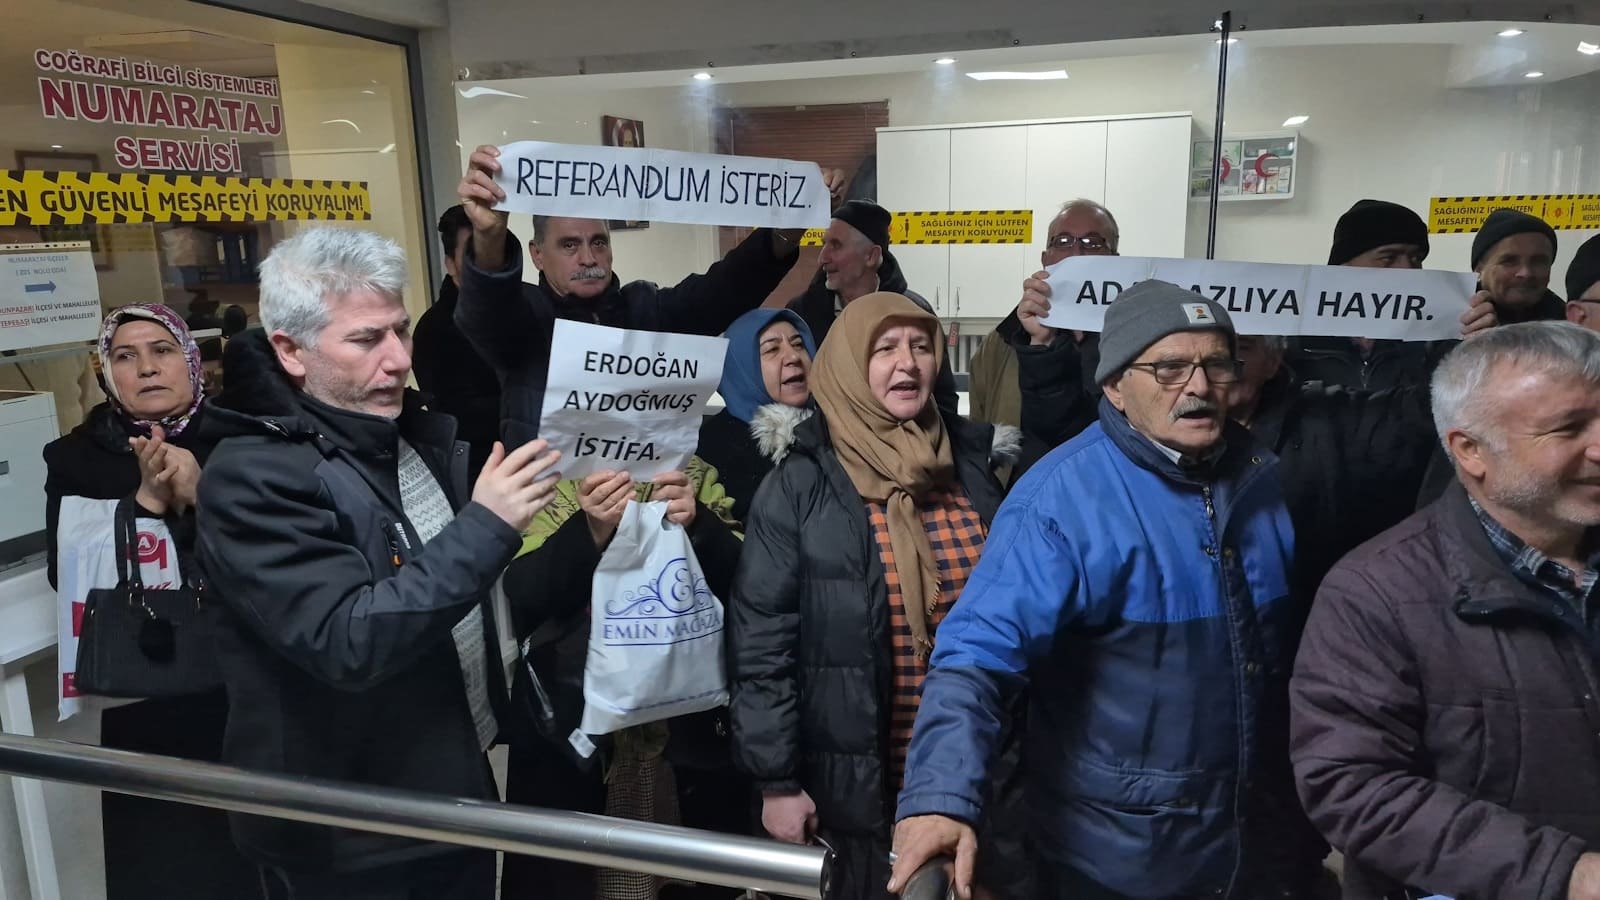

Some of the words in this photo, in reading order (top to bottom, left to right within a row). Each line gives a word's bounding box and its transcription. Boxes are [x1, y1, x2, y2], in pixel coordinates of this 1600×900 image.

[34, 48, 129, 80] COĞRAFİ
[133, 59, 183, 86] BİLGİ
[186, 66, 279, 98] SİSTEMLERİ
[38, 76, 282, 137] NUMARATAJ
[115, 135, 242, 173] SERVİSİ
[516, 156, 710, 203] REFERANDUM
[720, 164, 812, 209] İSTERİZ.
[40, 185, 149, 212] GÜVENLİ
[158, 188, 259, 212] MESAFEYİ
[266, 192, 363, 212] KORUYALIM!
[921, 219, 971, 227] SAĞLIĞINIZ
[975, 219, 993, 227] İÇİN
[996, 218, 1028, 226] LÜTFEN
[925, 229, 964, 237] MESAFEYİ
[1317, 290, 1434, 321] HAYIR.
[584, 351, 698, 379] ERDOĞAN
[563, 390, 697, 413] AYDOĞMUŞ
[574, 432, 661, 461] İSTİFA.
[603, 621, 658, 640] EMİN
